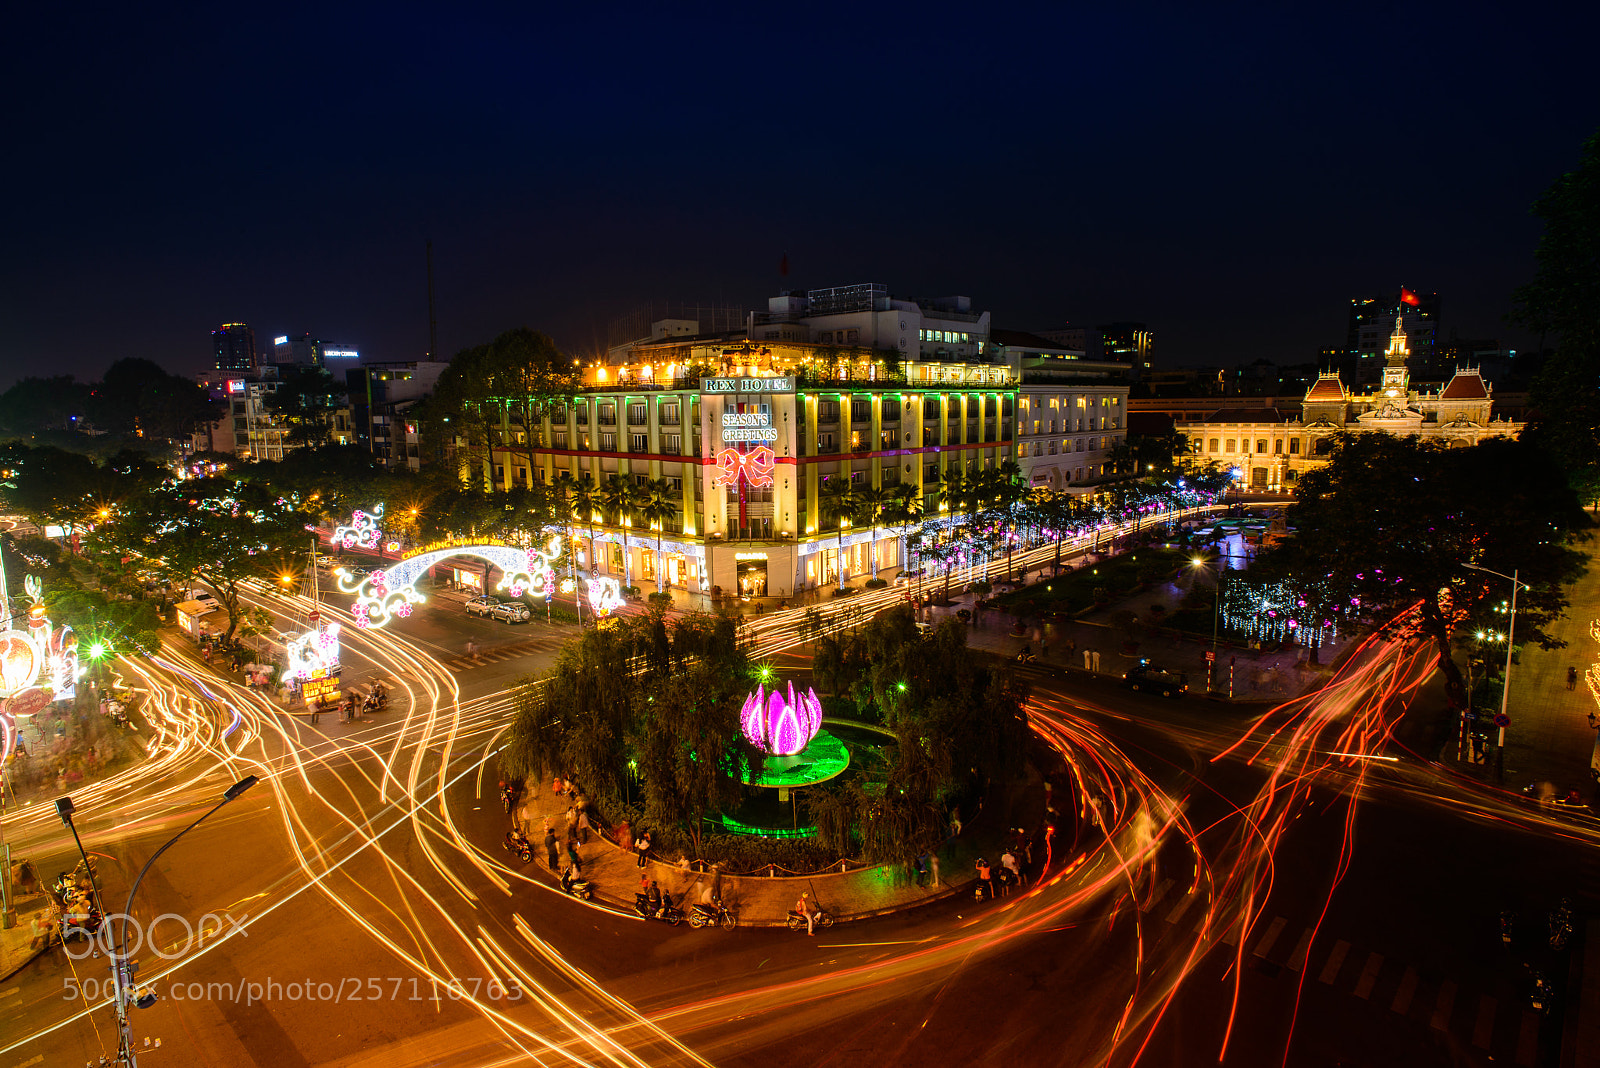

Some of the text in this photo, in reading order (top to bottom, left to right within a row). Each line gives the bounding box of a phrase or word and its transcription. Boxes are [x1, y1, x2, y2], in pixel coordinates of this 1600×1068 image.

[705, 379, 792, 391] REX HOTEL
[722, 413, 768, 426] SEASON'S
[722, 428, 778, 442] GREETINGS
[401, 546, 425, 560] CHÚC
